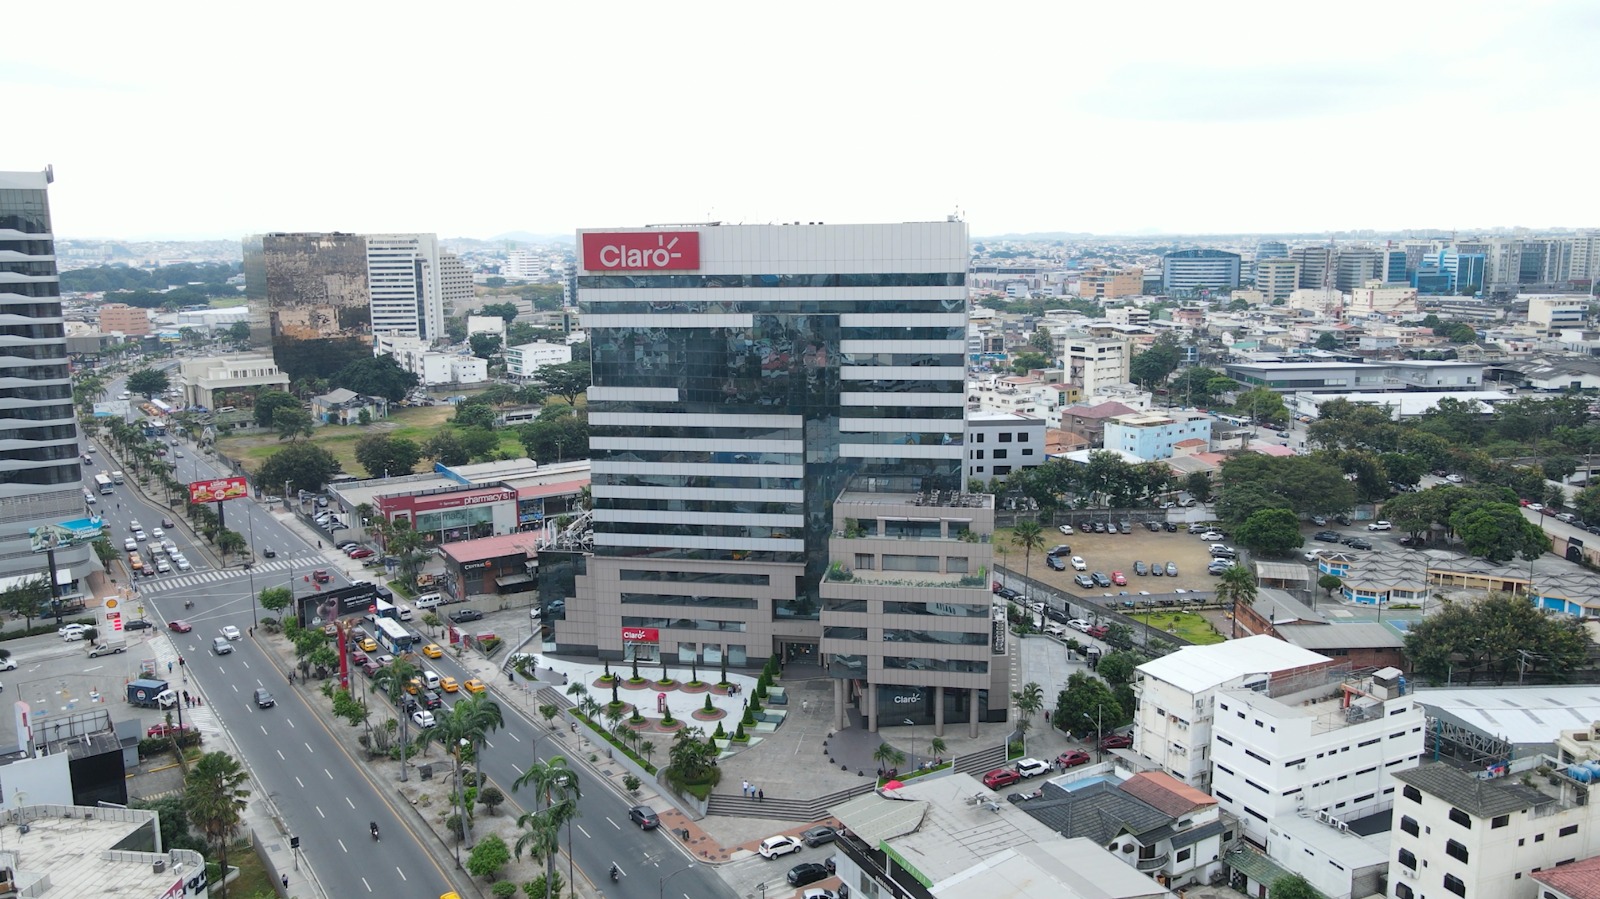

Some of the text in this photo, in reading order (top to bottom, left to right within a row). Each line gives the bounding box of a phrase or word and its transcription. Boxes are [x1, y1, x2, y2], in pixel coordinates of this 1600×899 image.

[600, 238, 676, 267] Claro
[464, 492, 508, 505] pharmacy's
[624, 630, 644, 639] Claro
[894, 694, 918, 703] Claro
